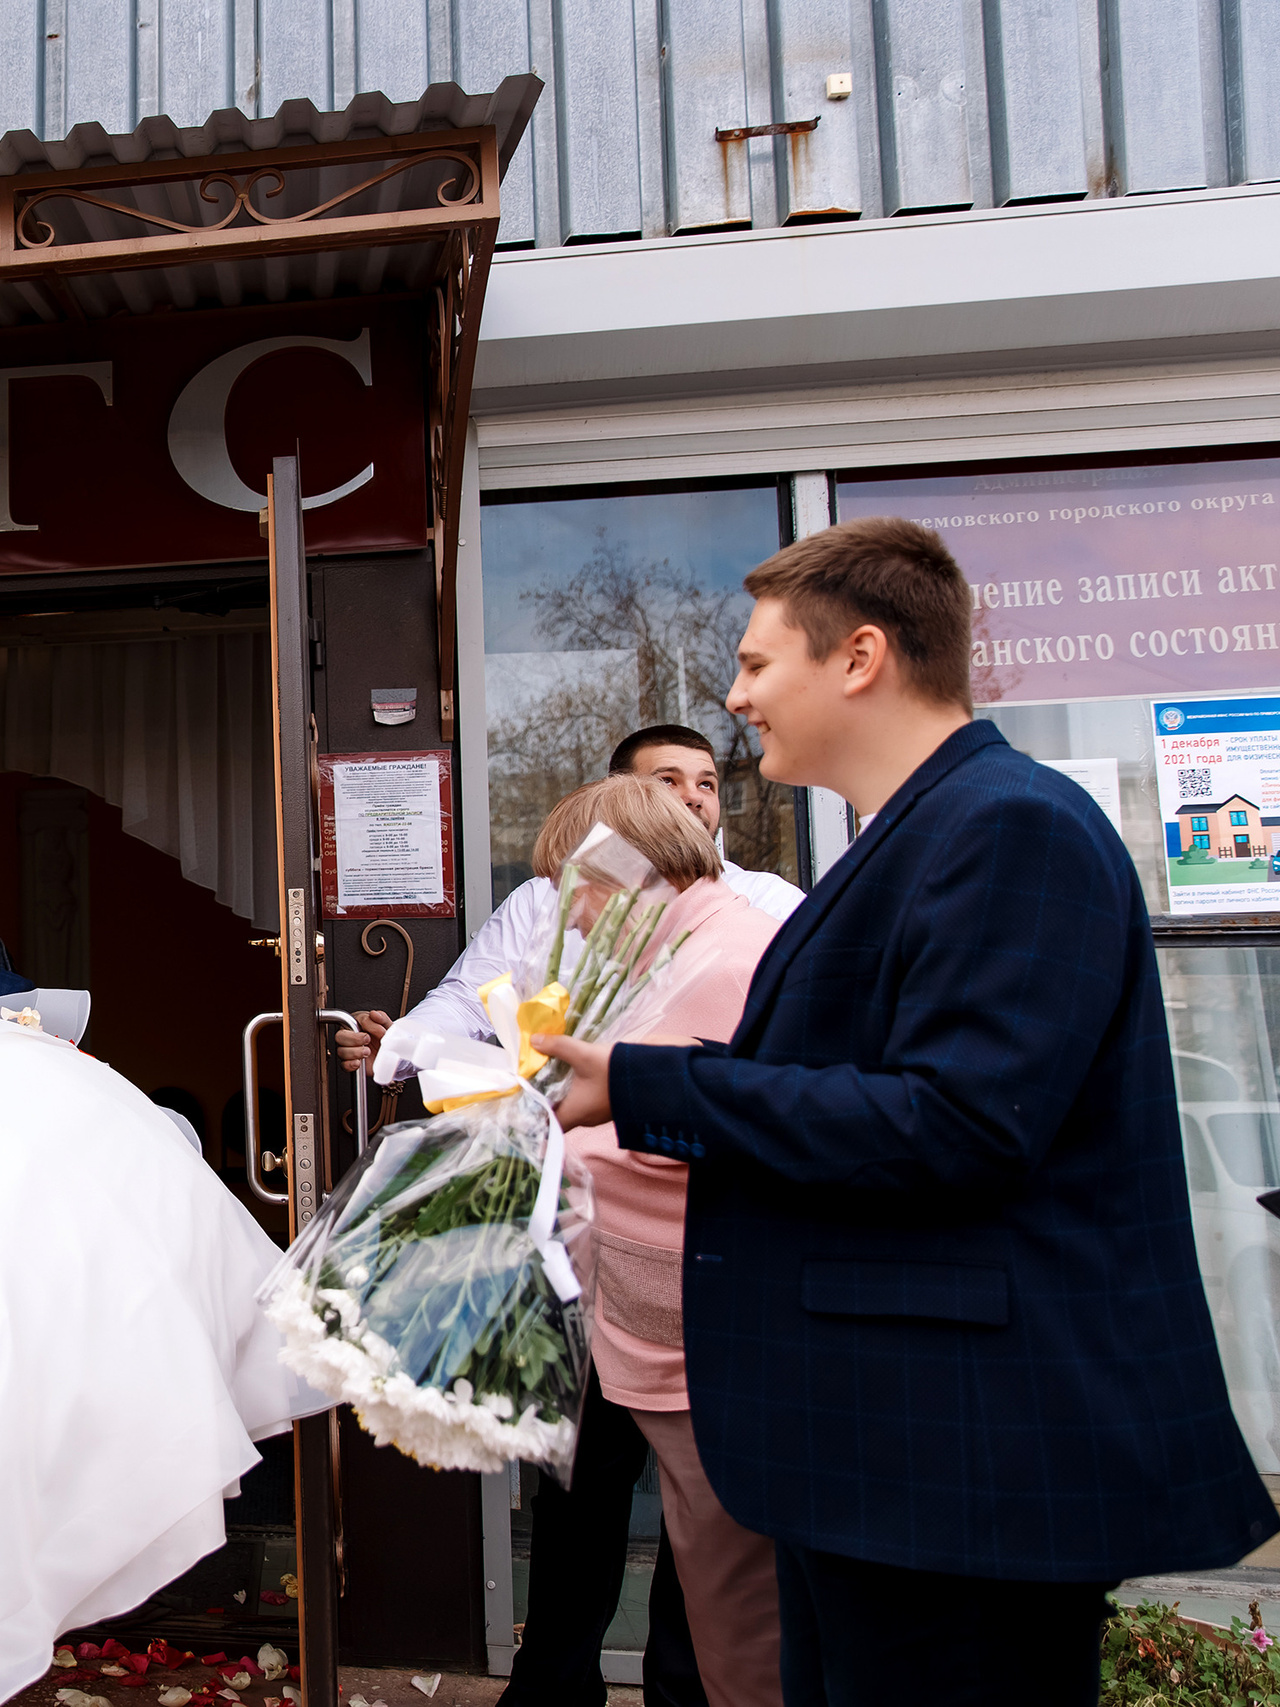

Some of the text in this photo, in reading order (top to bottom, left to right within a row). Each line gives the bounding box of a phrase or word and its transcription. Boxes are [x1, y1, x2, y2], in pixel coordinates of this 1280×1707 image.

[907, 489, 1275, 530] темовского городского округа
[970, 577, 1064, 610] ление
[1078, 569, 1202, 604] записи
[970, 622, 1280, 668] анского состоян
[1161, 737, 1220, 750] 1 декабря
[1164, 754, 1223, 765] 2021 года
